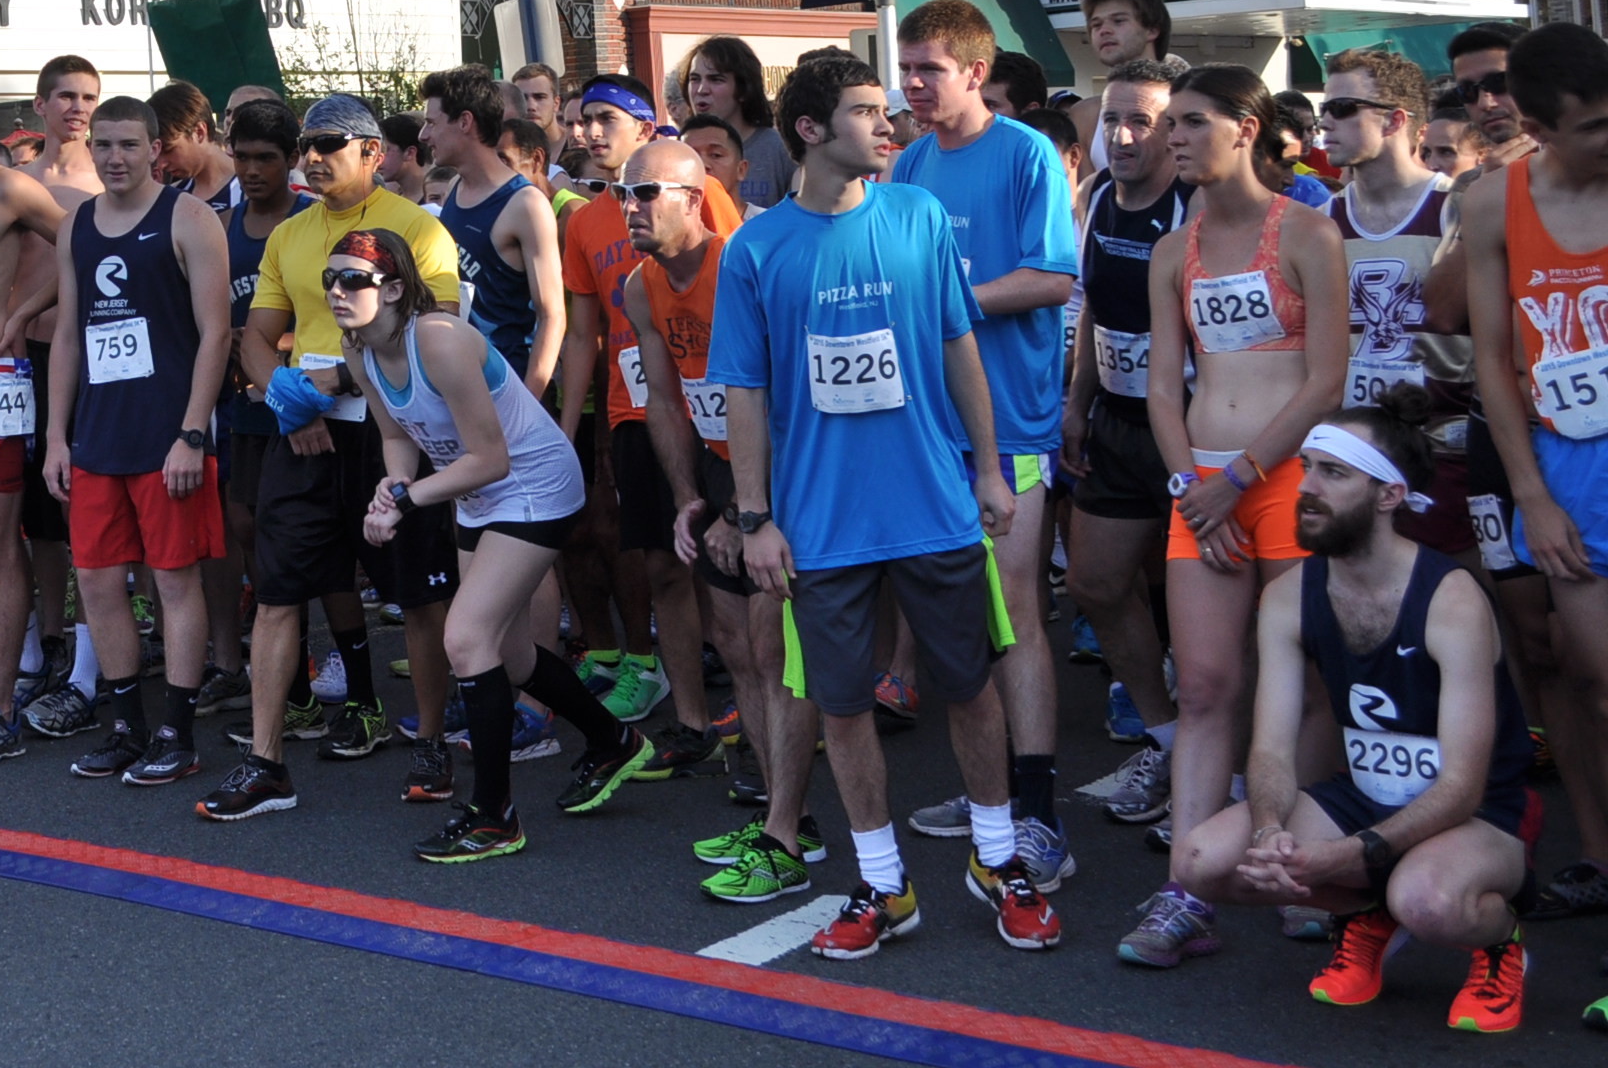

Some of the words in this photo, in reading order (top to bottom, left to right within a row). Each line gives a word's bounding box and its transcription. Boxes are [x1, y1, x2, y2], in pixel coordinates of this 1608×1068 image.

[456, 243, 482, 281] ELD
[818, 285, 859, 305] PIZZA
[864, 281, 893, 298] RUN
[1193, 289, 1269, 326] 1828
[95, 334, 138, 361] 759
[1097, 341, 1149, 373] 1354
[630, 361, 647, 385] 2
[813, 349, 896, 386] 1226
[1353, 375, 1406, 401] 50
[264, 393, 285, 413] PIZZ
[1349, 739, 1438, 780] 2296
